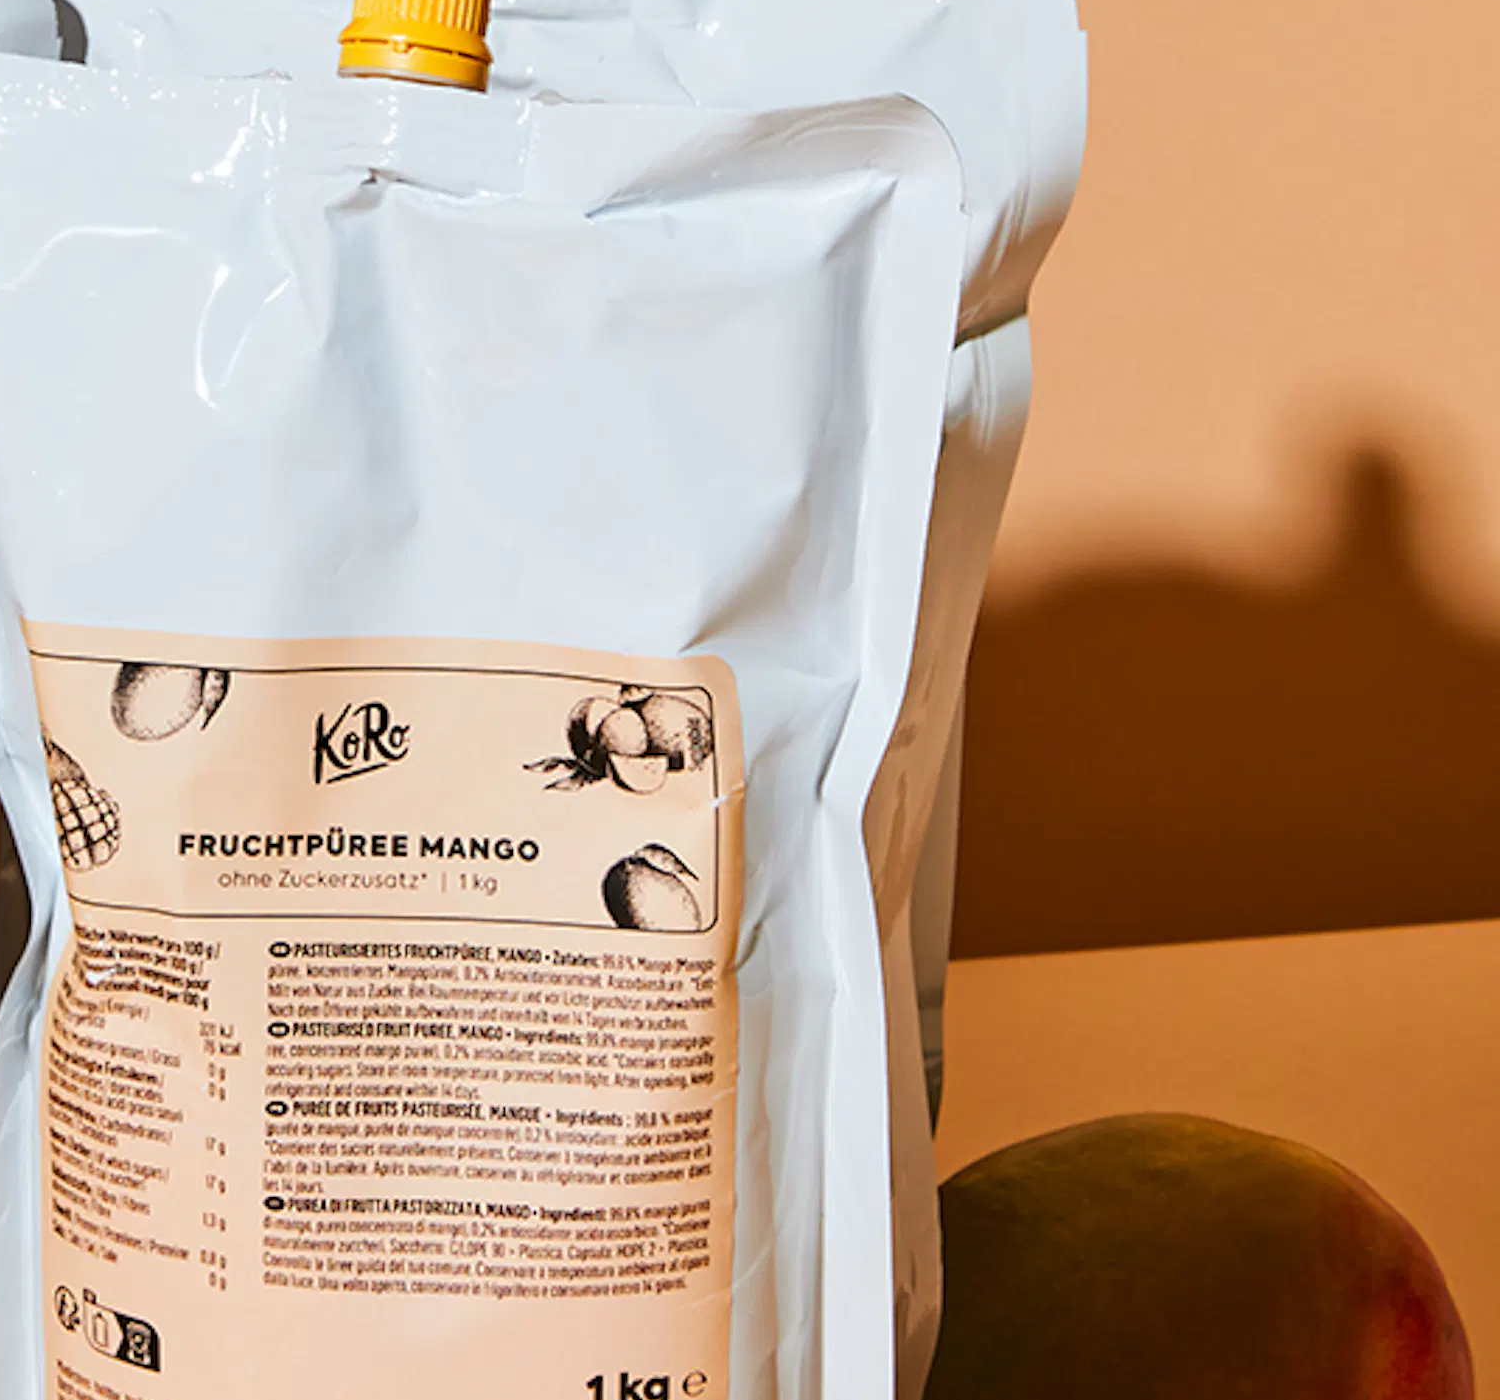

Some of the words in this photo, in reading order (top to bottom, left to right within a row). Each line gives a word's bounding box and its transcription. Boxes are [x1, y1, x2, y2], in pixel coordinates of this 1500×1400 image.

[313, 701, 410, 784] KoRo
[179, 826, 408, 858] FRUCHTPÜREE
[420, 834, 539, 862] MANGO
[217, 870, 273, 890] ohne
[497, 946, 542, 963] MANGO
[458, 1025, 504, 1042] MANGO
[355, 1100, 398, 1118] FRUITS
[490, 1105, 541, 1122] MANGUE
[486, 1202, 531, 1219] MANGO
